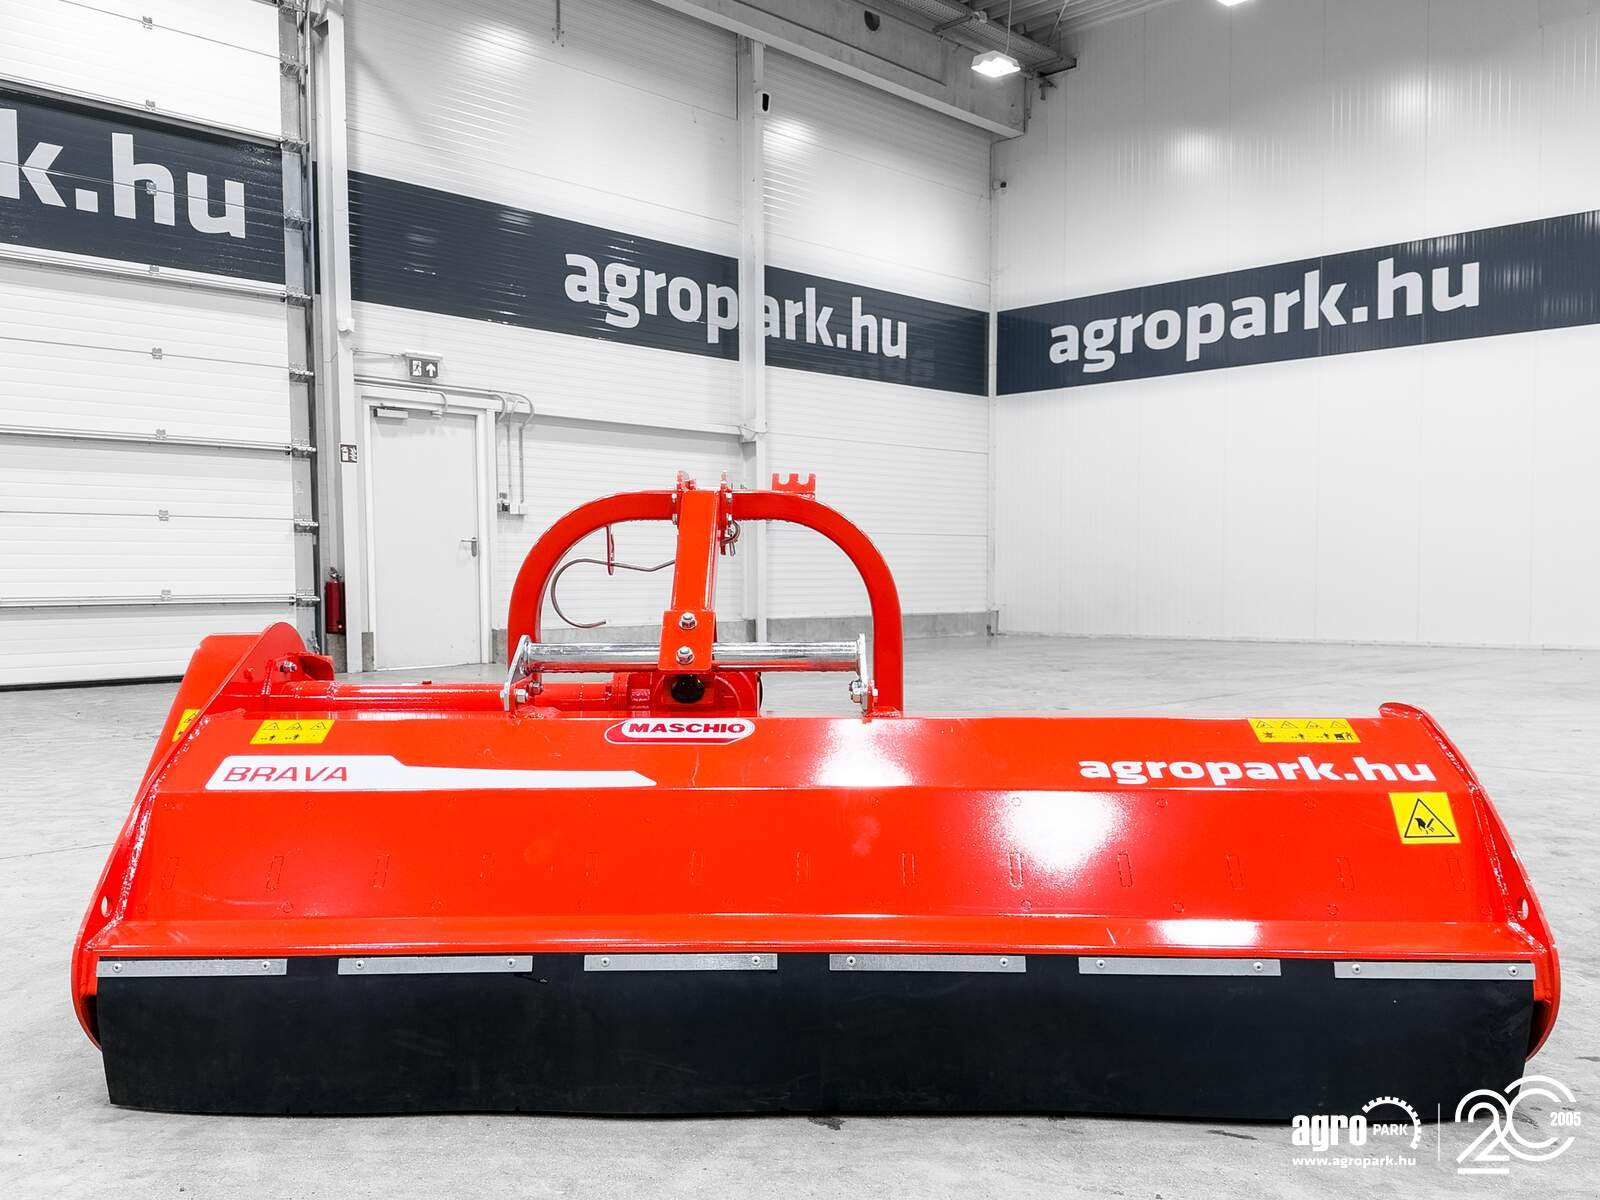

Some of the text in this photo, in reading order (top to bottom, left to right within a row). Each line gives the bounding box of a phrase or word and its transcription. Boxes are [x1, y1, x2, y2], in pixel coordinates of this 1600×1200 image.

[0, 107, 246, 239] k.hu
[1049, 257, 1481, 374] agropark.hu
[628, 723, 746, 733] MASCHIO
[223, 766, 348, 782] BRAVA
[1078, 756, 1437, 786] agropark.hu
